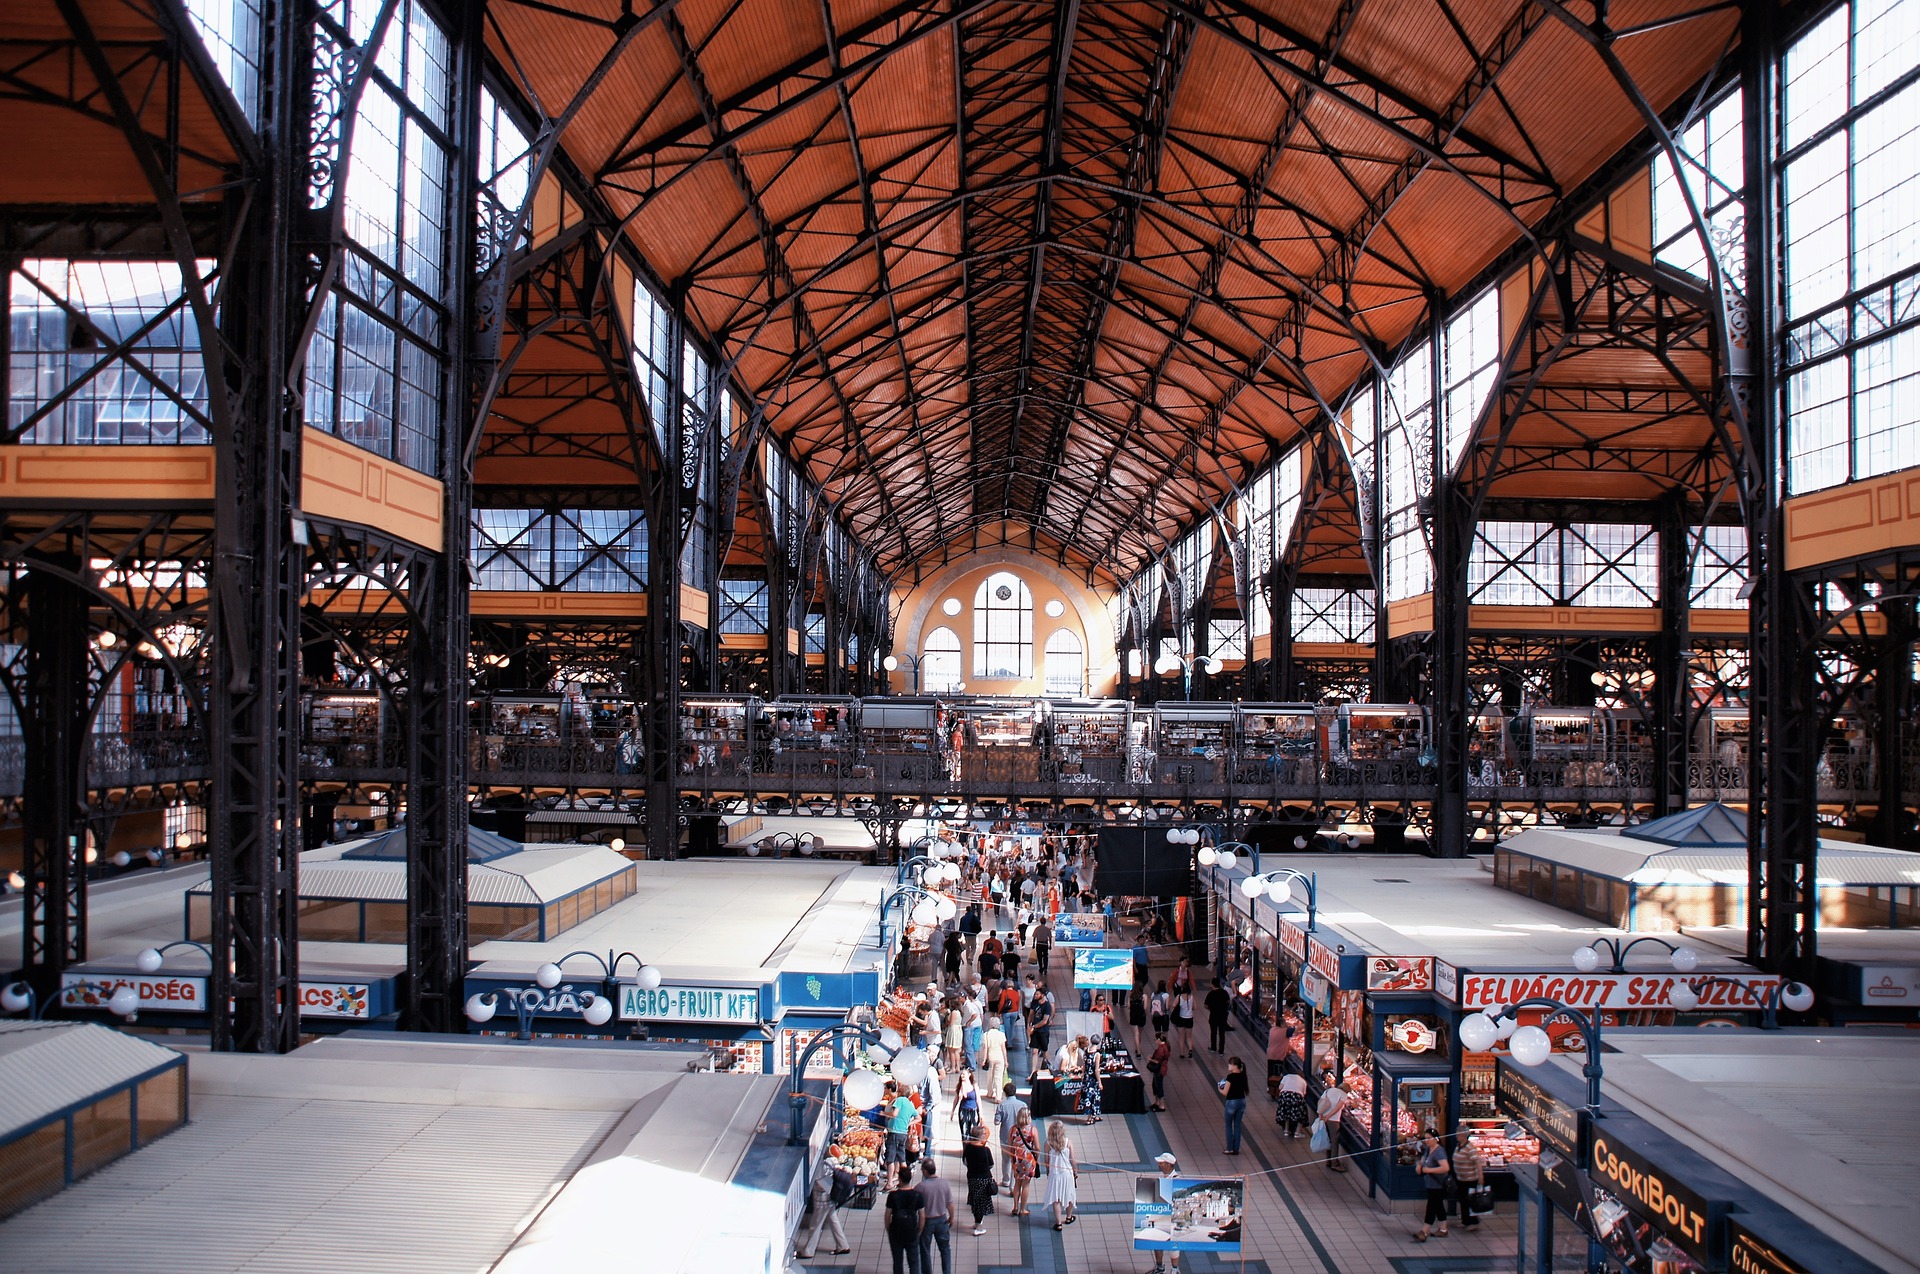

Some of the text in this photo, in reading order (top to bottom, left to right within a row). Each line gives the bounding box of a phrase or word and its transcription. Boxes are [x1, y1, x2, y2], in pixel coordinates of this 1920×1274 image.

[100, 978, 196, 1001] ZÖDSÉG
[625, 988, 724, 1018] AGRO-FRUIT
[1465, 975, 1618, 1006] FELVÁGOTT
[1627, 975, 1780, 1006] SZAÜZLET
